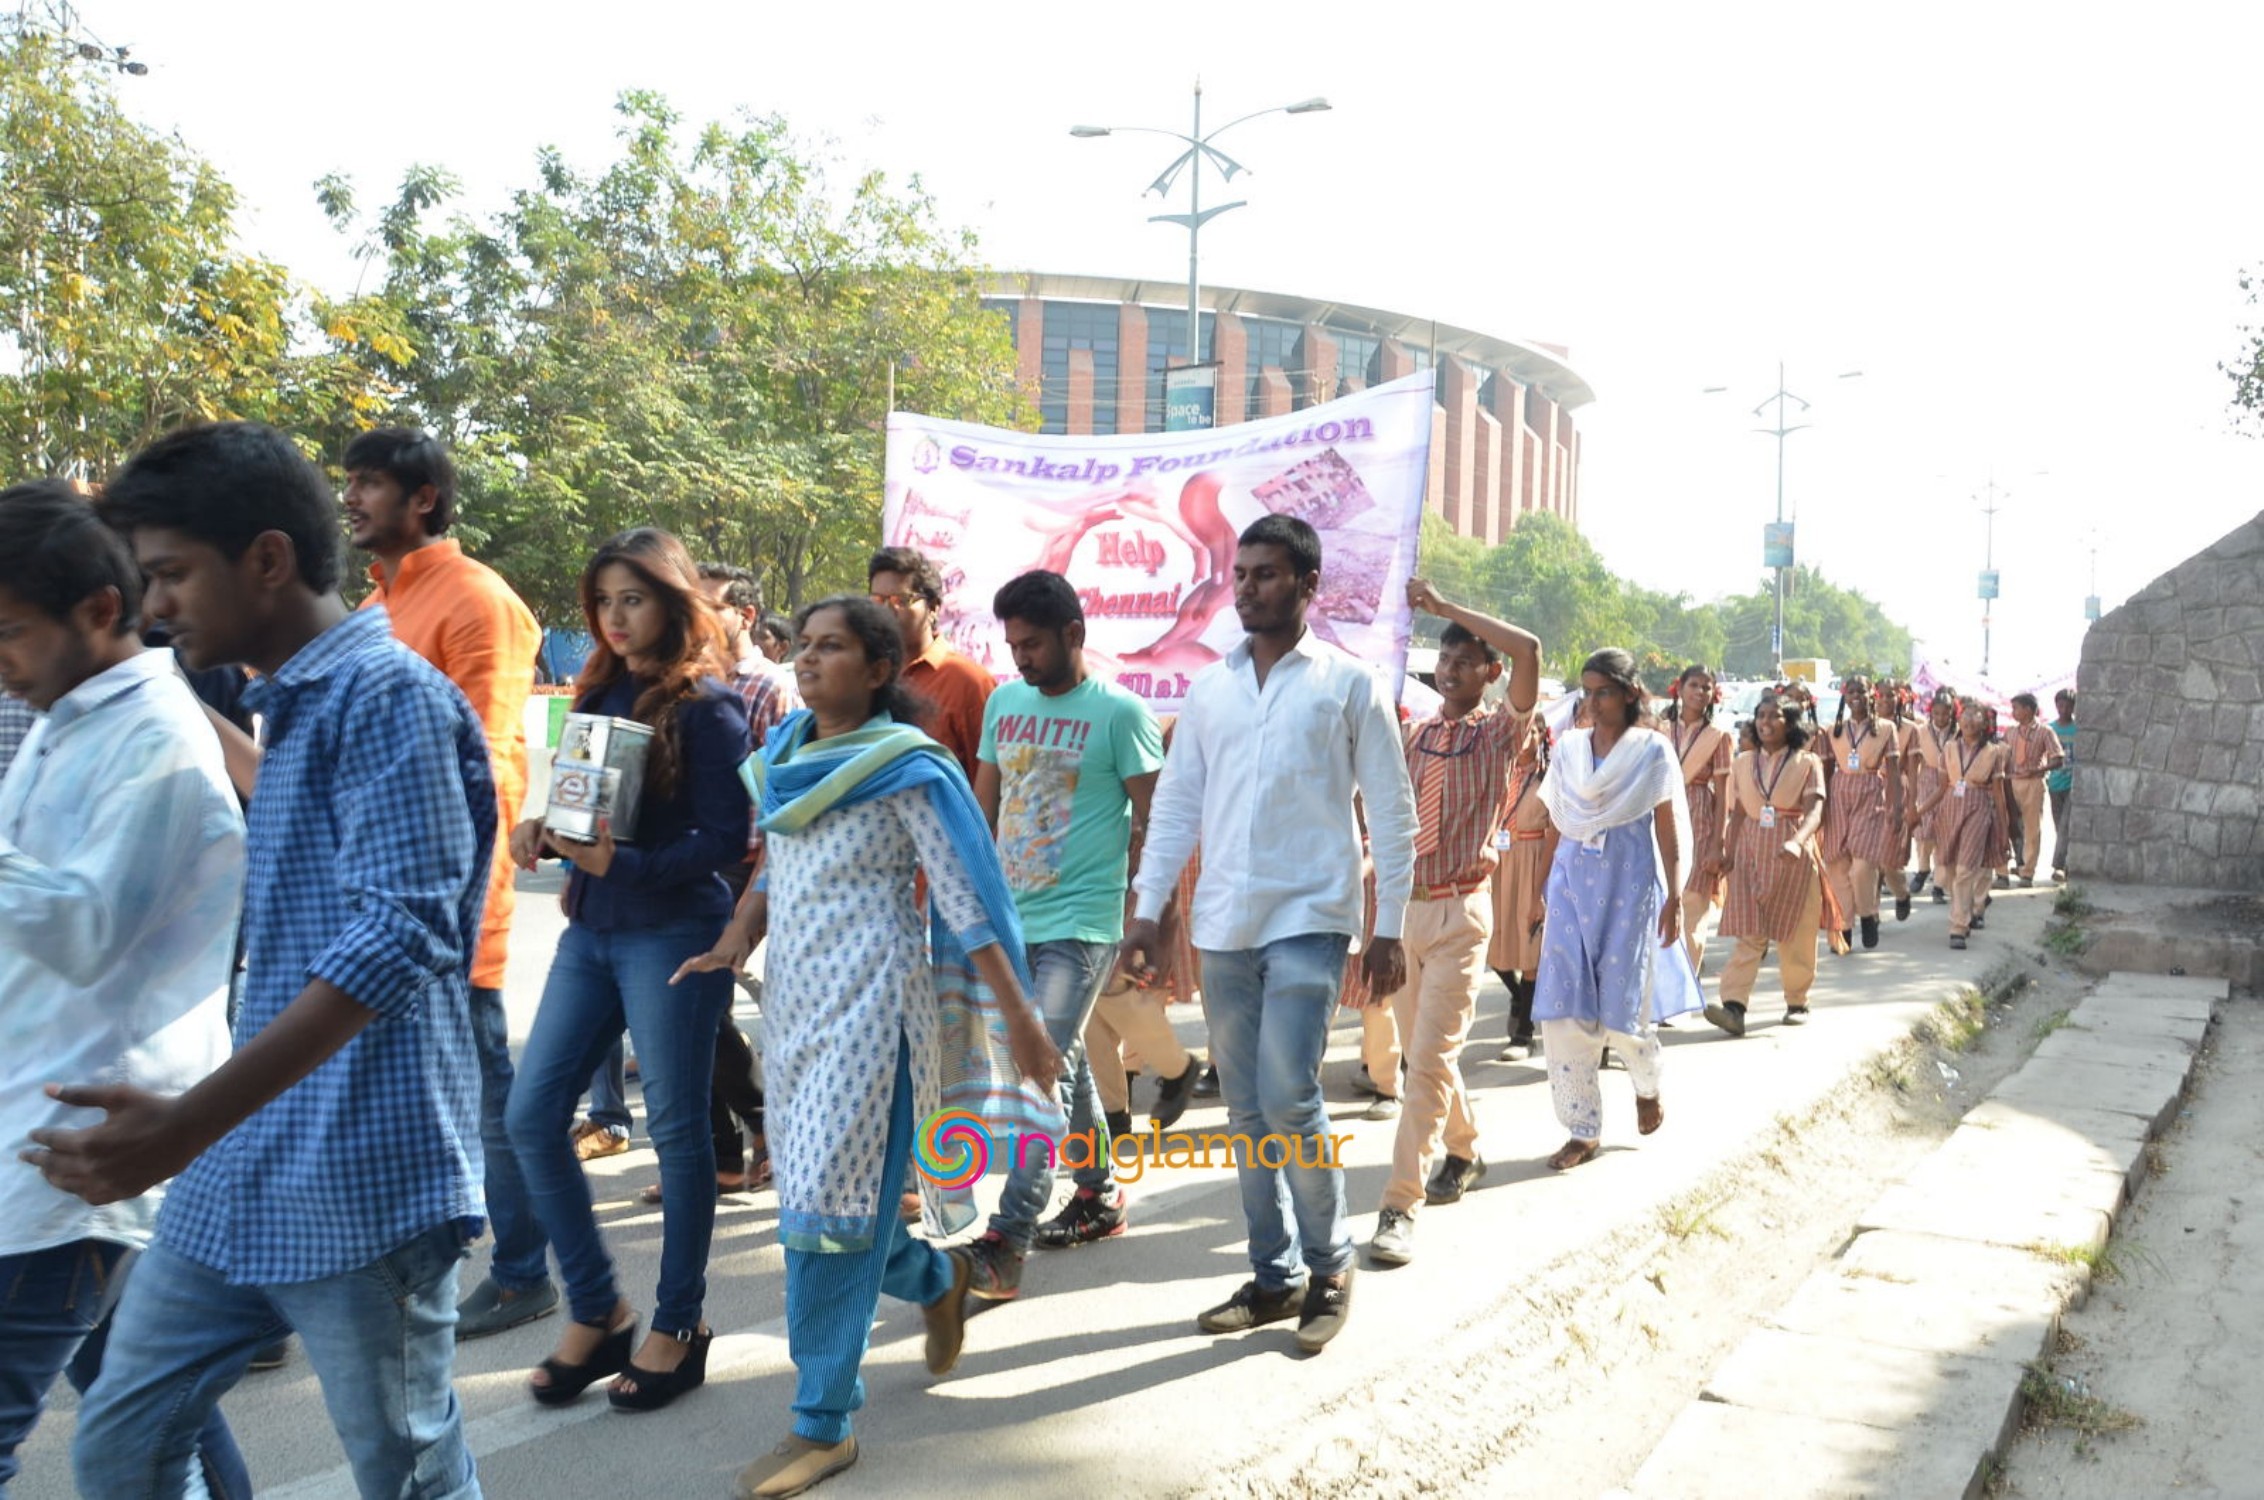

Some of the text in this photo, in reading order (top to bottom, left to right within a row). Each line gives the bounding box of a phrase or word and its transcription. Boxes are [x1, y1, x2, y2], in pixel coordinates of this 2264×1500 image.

[1199, 414, 1212, 425] be
[950, 445, 1120, 484] Sankalp
[1095, 530, 1166, 577] Help
[996, 714, 1092, 752] WAIT!!
